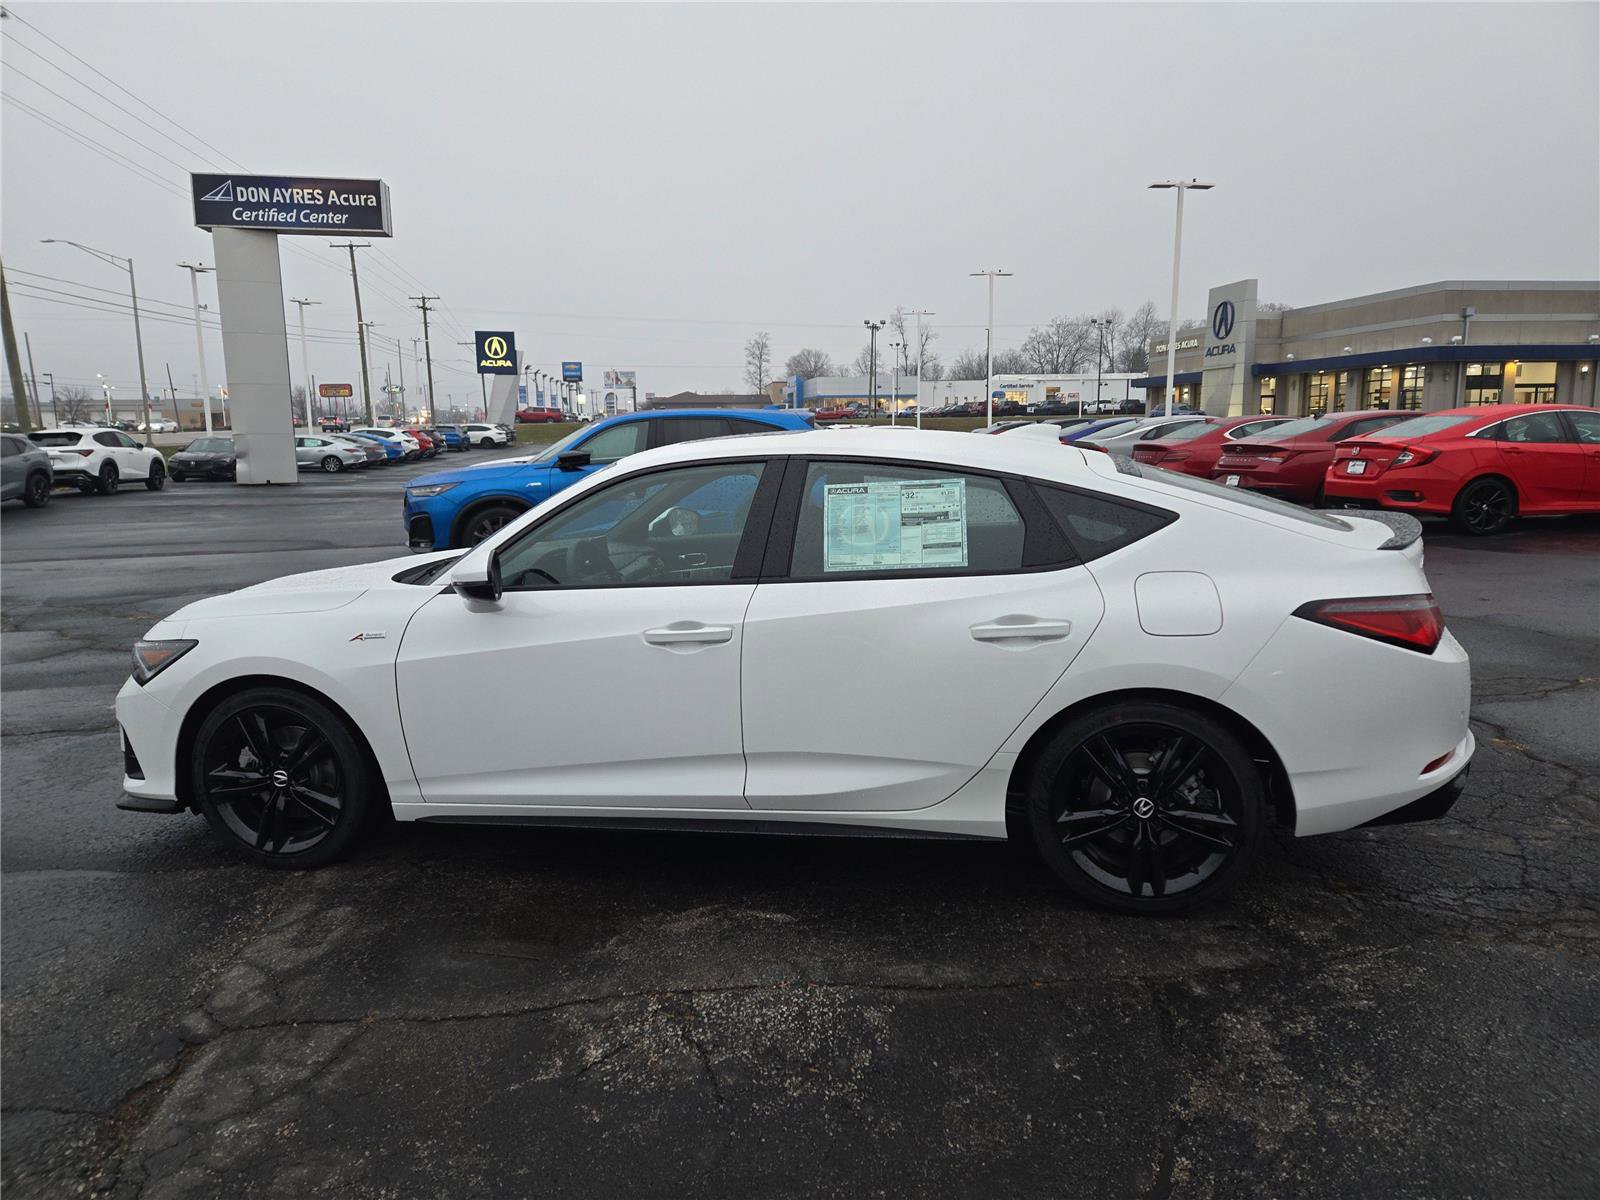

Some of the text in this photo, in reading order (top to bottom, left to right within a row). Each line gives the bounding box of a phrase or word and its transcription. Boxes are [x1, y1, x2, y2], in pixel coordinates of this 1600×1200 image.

[236, 186, 377, 207] DON AYRES Acura
[232, 207, 348, 224] Certified Center
[1156, 344, 1166, 353] DON
[1181, 338, 1198, 349] ACURA
[1205, 343, 1236, 358] ACURA
[480, 359, 513, 367] ACURA
